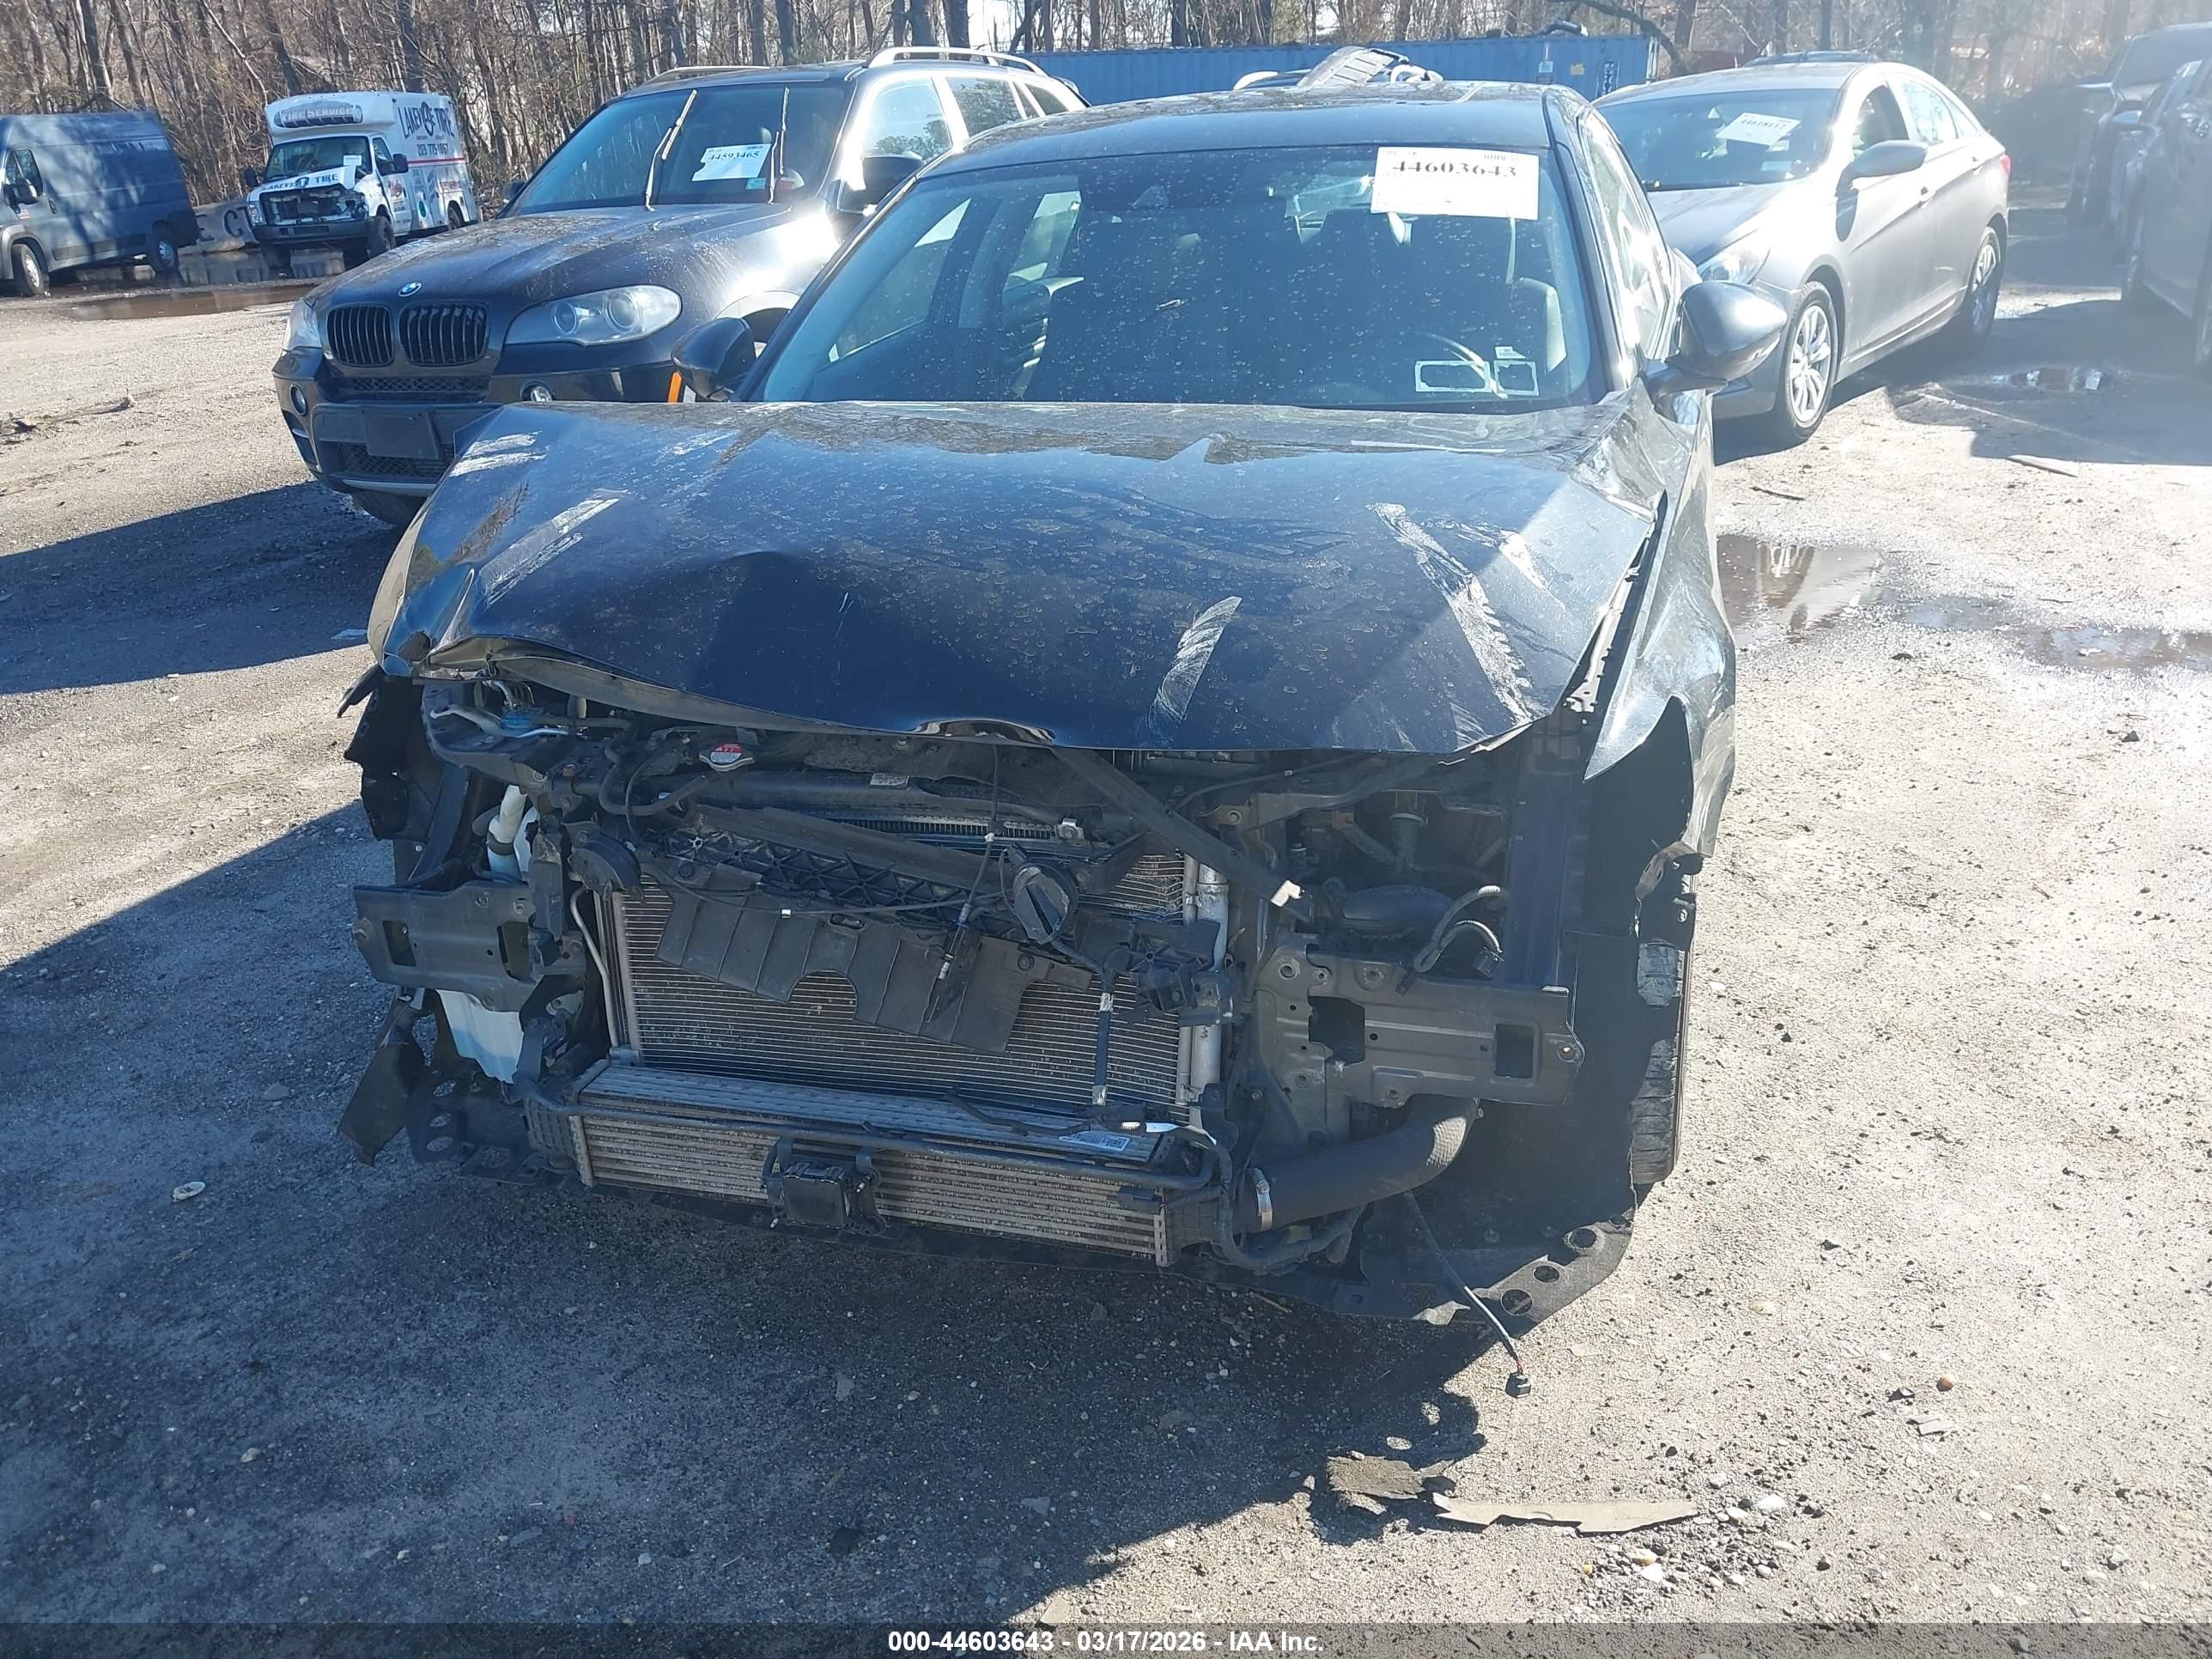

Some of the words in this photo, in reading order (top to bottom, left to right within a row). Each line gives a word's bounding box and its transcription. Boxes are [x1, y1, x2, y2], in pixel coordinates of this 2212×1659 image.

[283, 112, 305, 121] TIRE
[306, 107, 354, 118] SERVICE
[434, 107, 455, 138] TIRE
[1393, 161, 1516, 178] 44603643
[314, 173, 338, 184] TIRE
